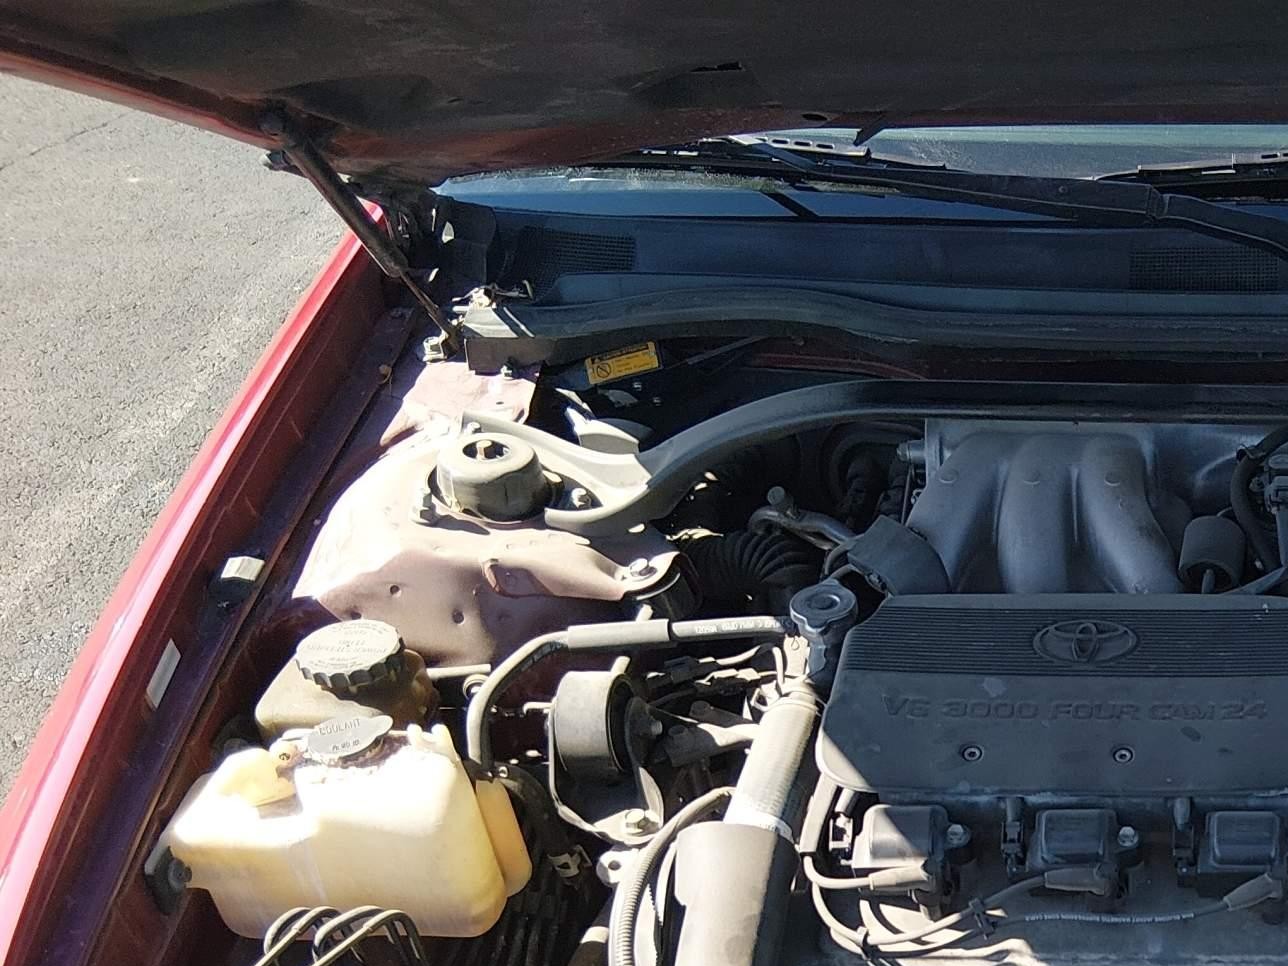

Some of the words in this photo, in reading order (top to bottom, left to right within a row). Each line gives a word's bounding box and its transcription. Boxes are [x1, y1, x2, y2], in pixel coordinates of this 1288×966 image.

[880, 694, 931, 718] V6
[941, 698, 1040, 720] 3000
[1049, 699, 1141, 721] FOUR
[1147, 700, 1219, 722] CAM
[1220, 700, 1271, 721] 24
[318, 717, 361, 736] COOLANT
